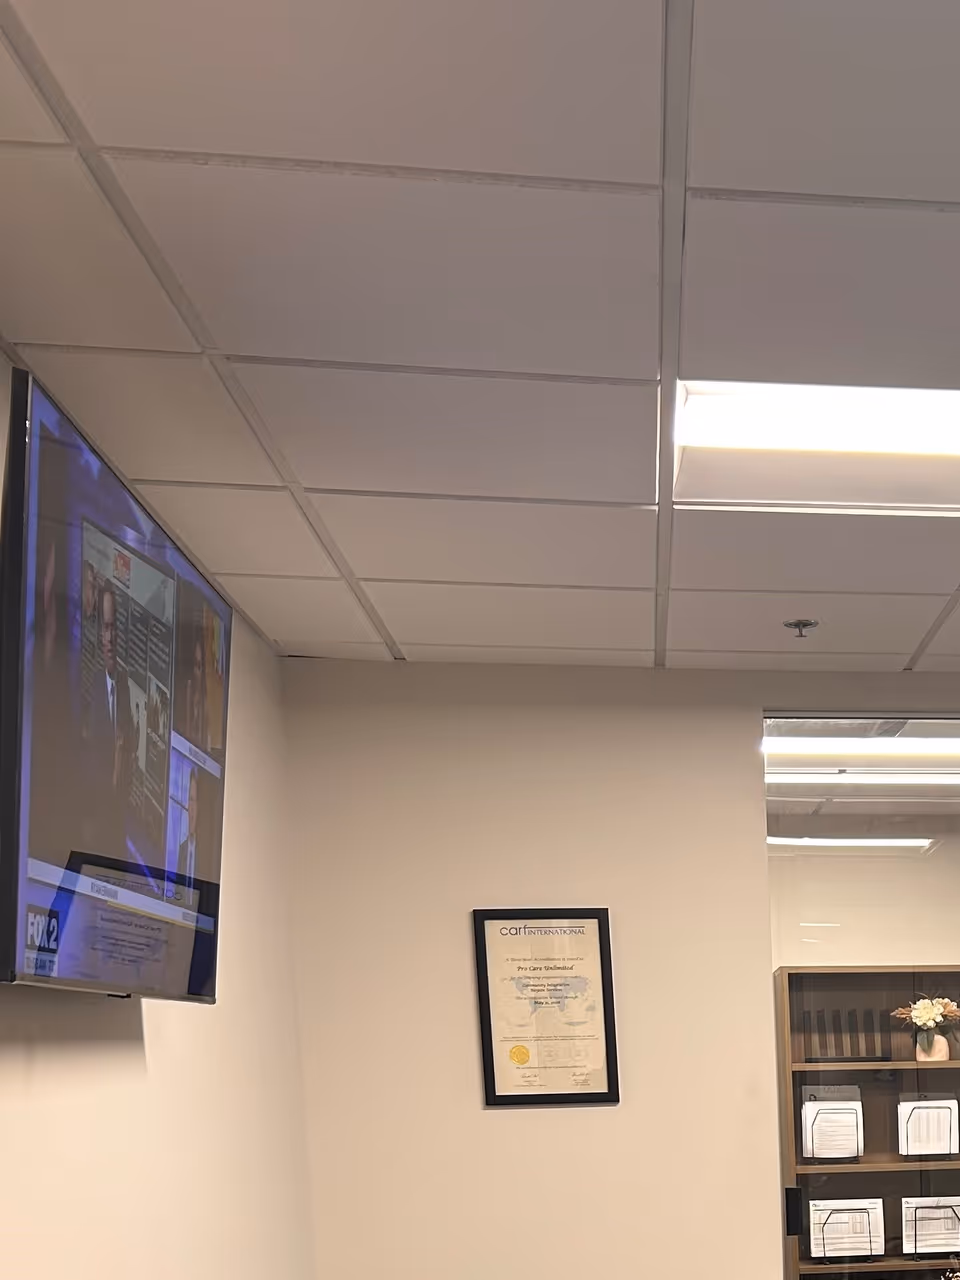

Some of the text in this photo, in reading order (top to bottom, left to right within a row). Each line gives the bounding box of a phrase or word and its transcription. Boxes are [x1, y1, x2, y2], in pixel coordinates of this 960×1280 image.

[28, 911, 58, 949] FOX 2
[500, 924, 586, 936] carf INTERNATIONAL
